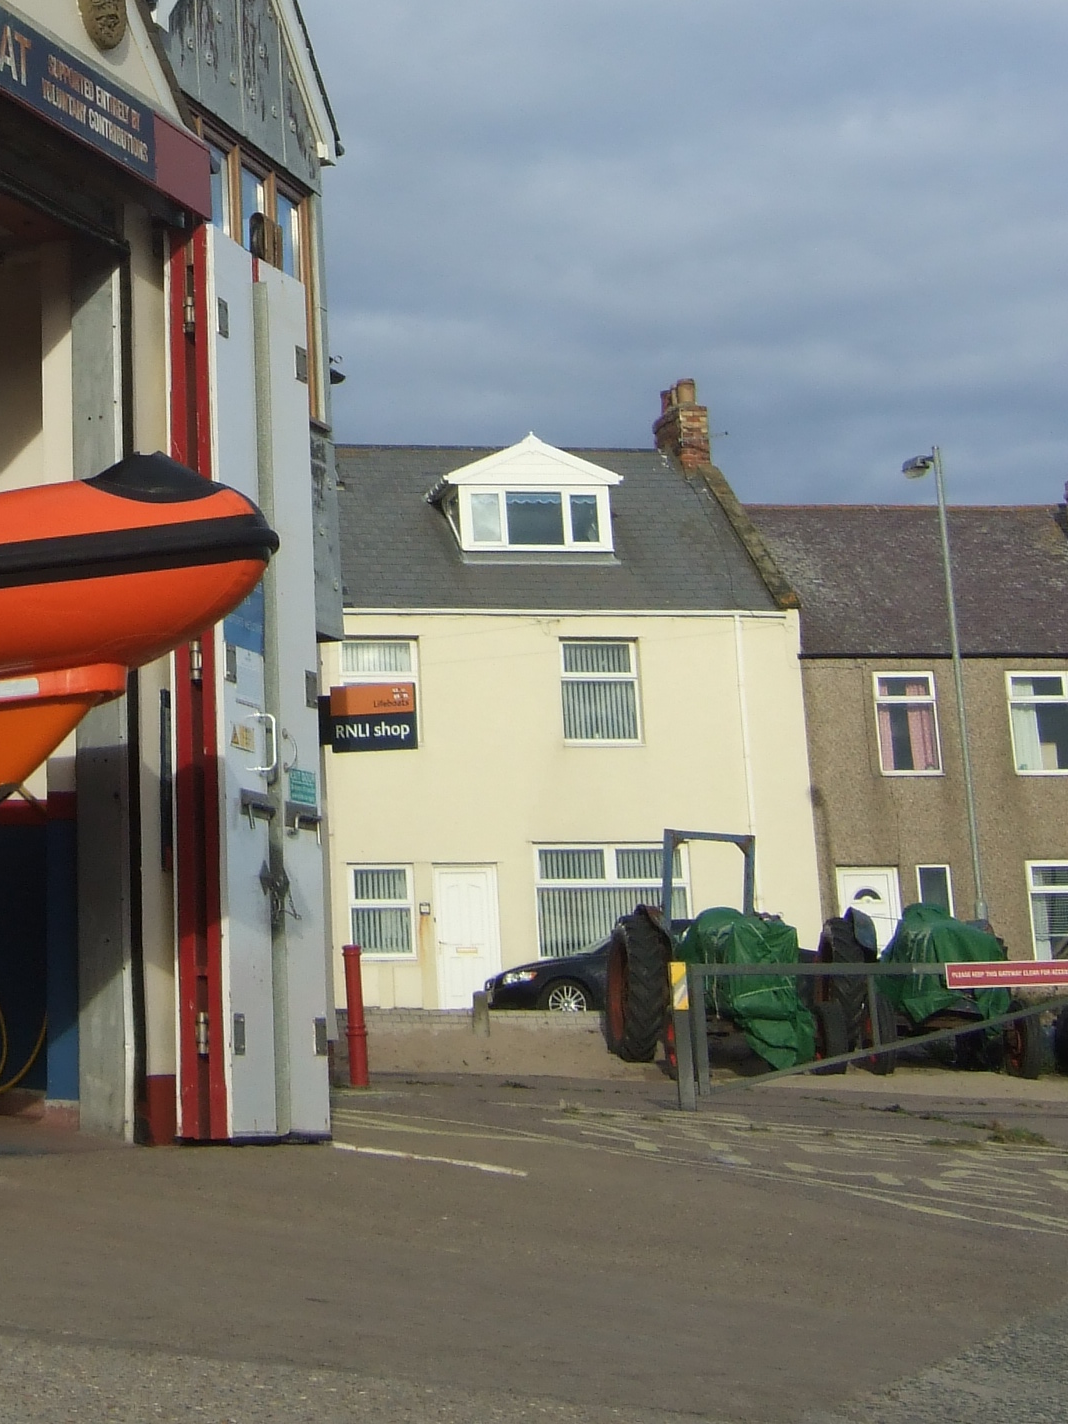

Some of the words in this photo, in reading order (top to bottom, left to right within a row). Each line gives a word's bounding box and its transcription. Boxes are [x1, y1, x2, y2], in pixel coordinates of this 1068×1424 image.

[88, 108, 148, 163] CONTRIBUTIONS
[373, 699, 409, 708] Lifeboats
[335, 723, 370, 739] RNLI
[373, 721, 410, 739] shop
